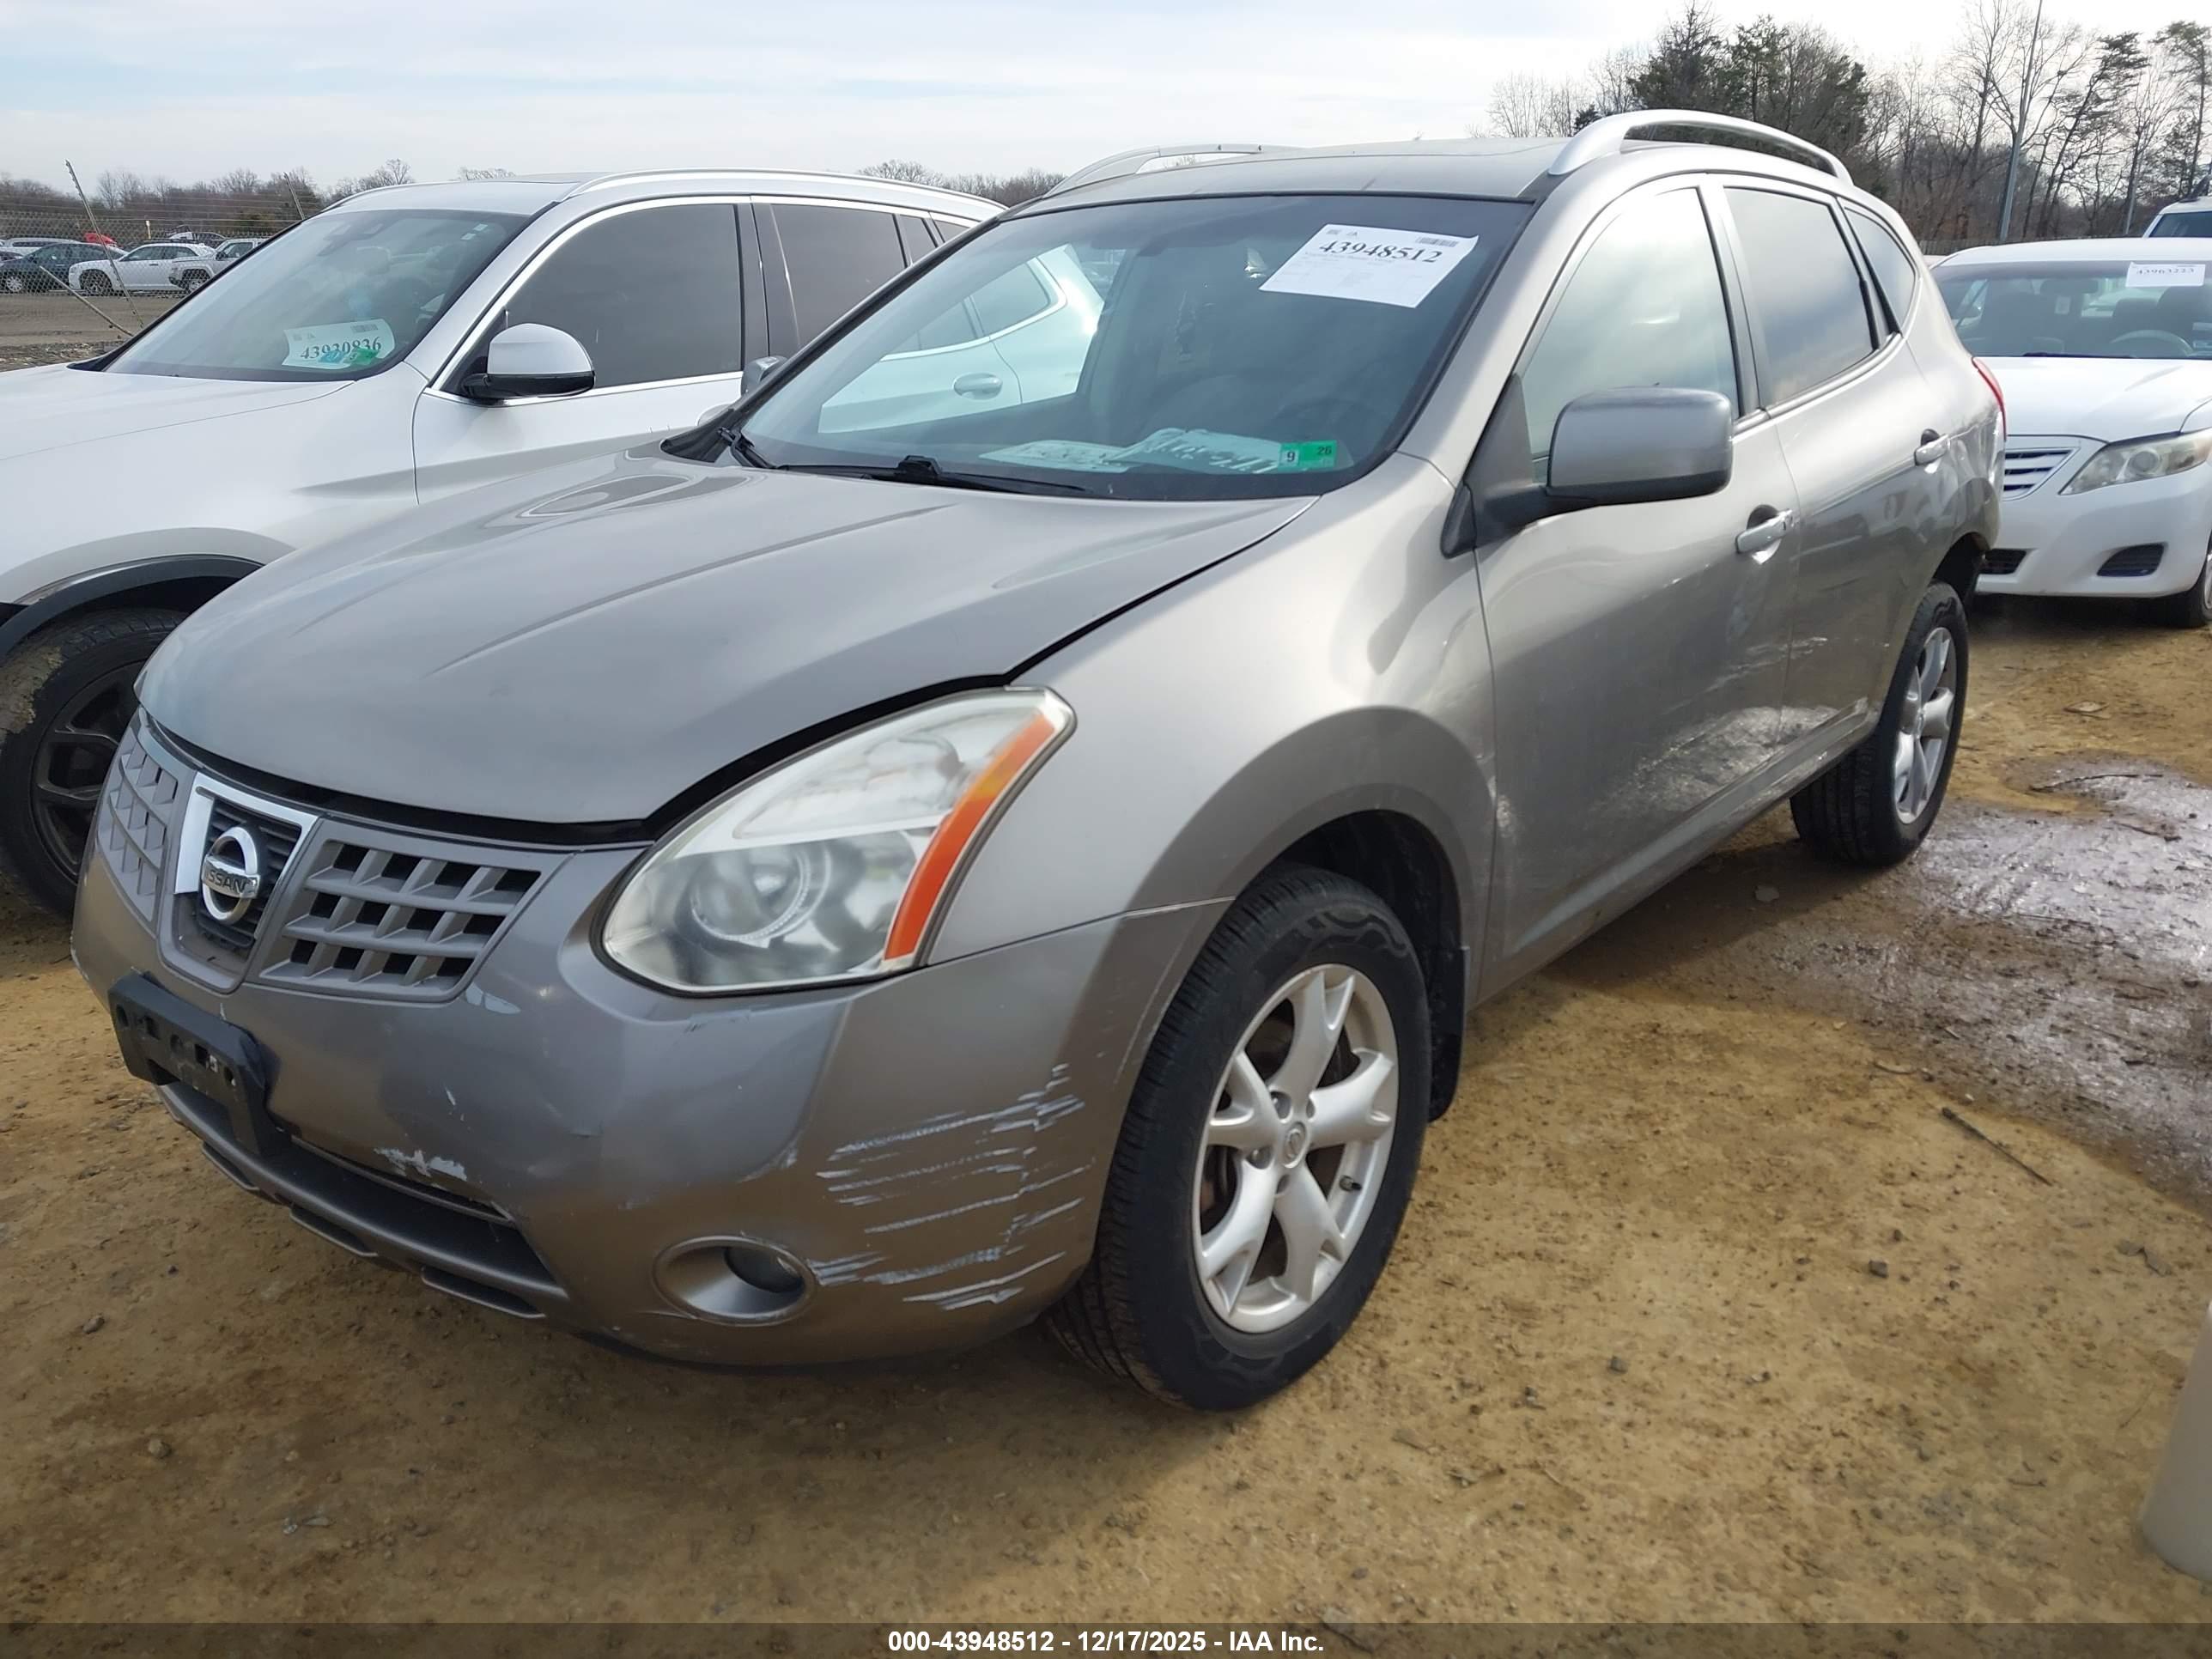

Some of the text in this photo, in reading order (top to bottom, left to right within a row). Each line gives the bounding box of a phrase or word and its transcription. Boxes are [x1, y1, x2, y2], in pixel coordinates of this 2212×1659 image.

[1319, 240, 1443, 263] 43948512
[1286, 446, 1333, 462] 9 26
